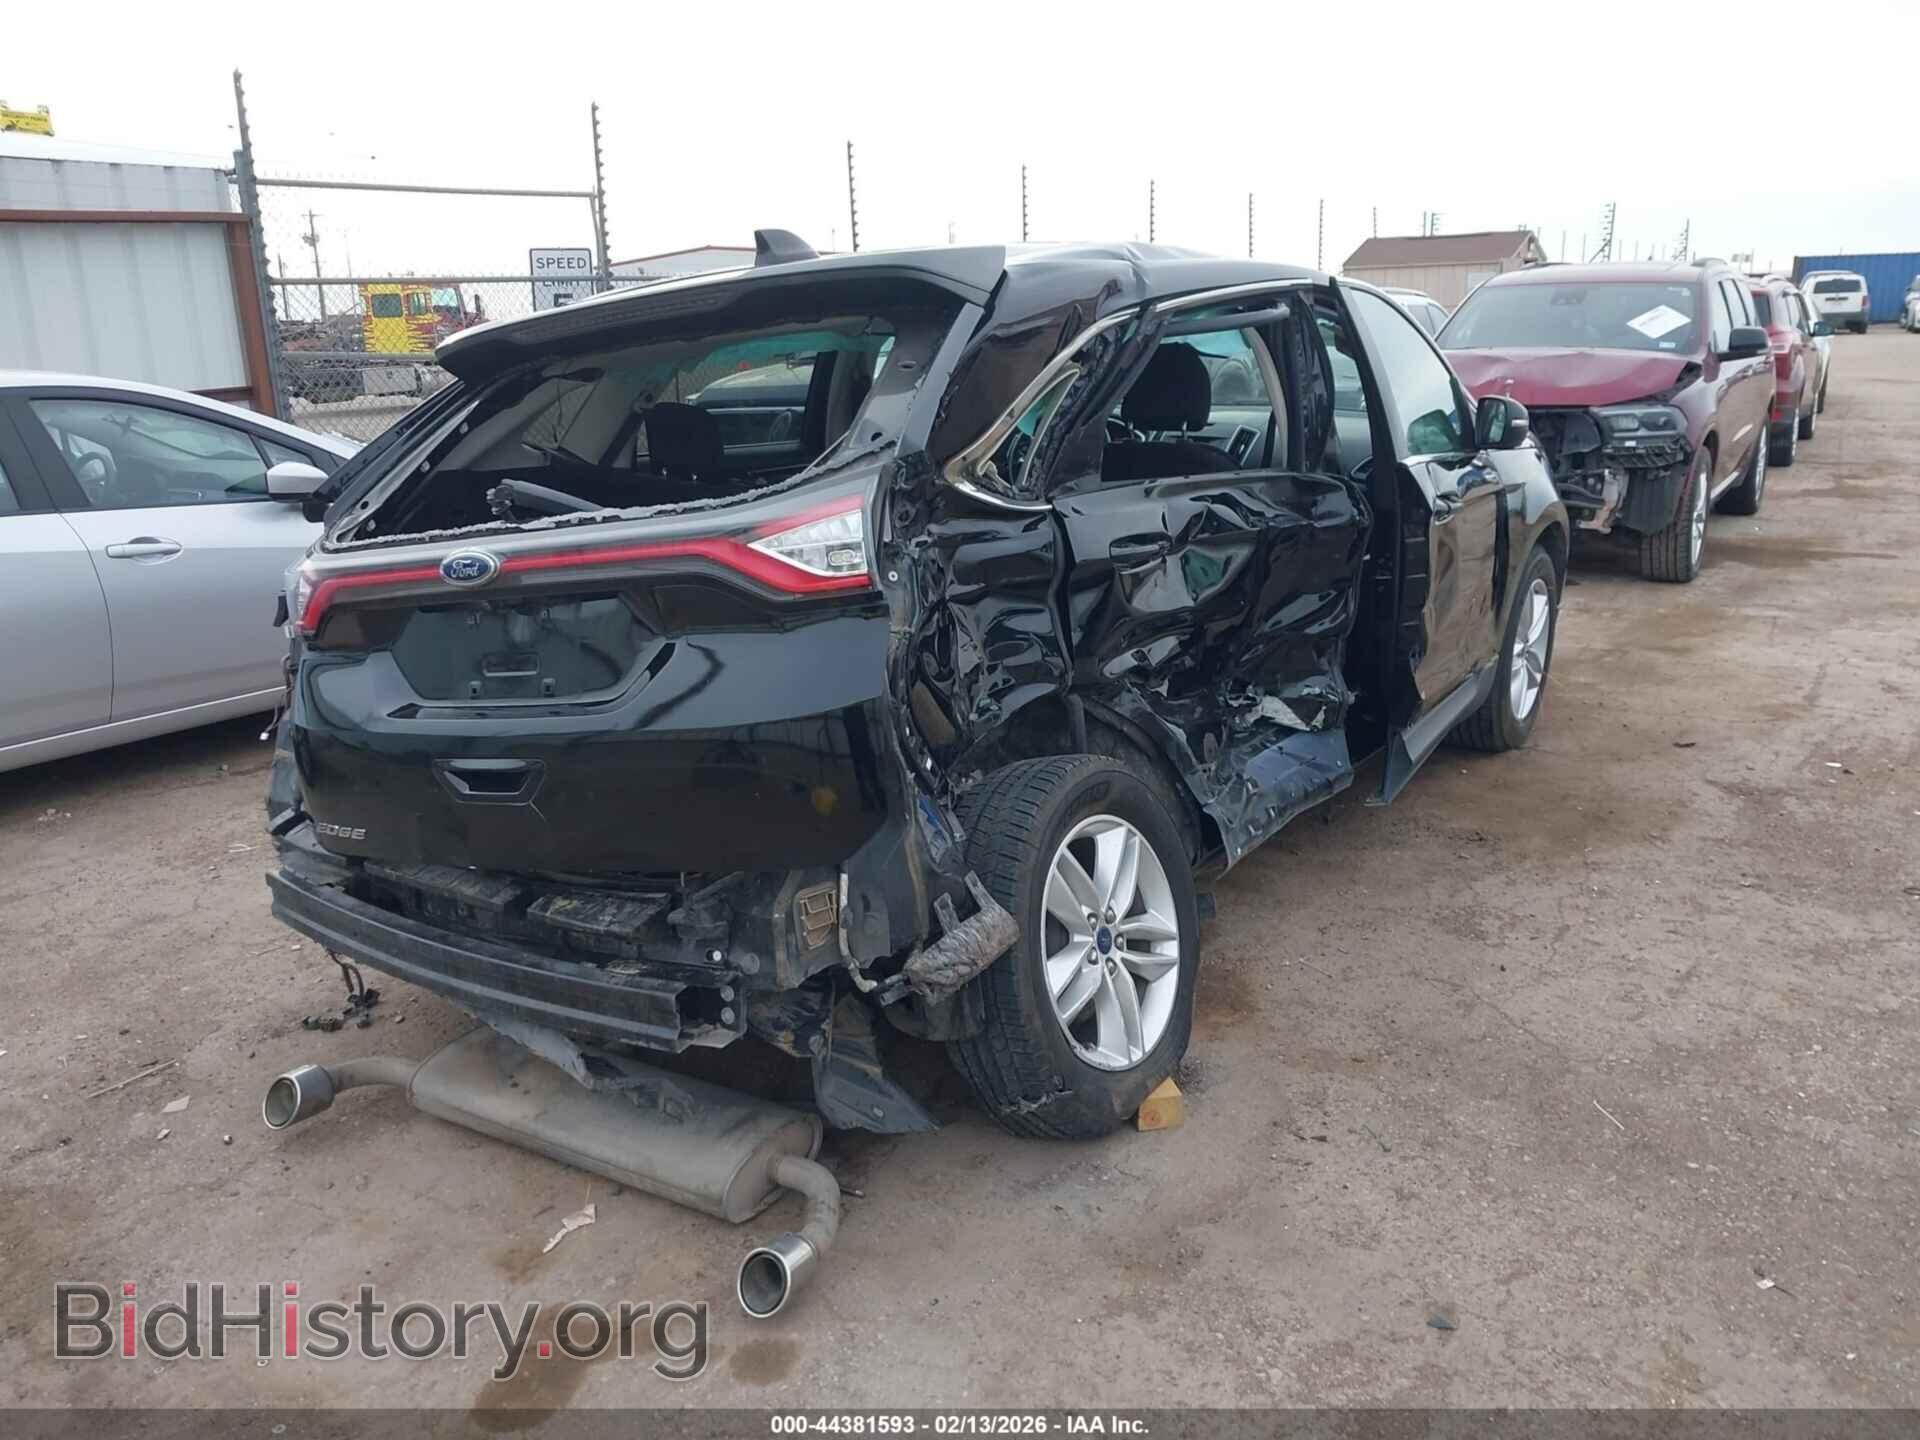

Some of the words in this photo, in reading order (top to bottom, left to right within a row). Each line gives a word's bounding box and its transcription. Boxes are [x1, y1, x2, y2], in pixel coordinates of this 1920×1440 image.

[536, 257, 586, 269] SPEED
[450, 559, 480, 578] Ford
[318, 822, 367, 840] EDGE
